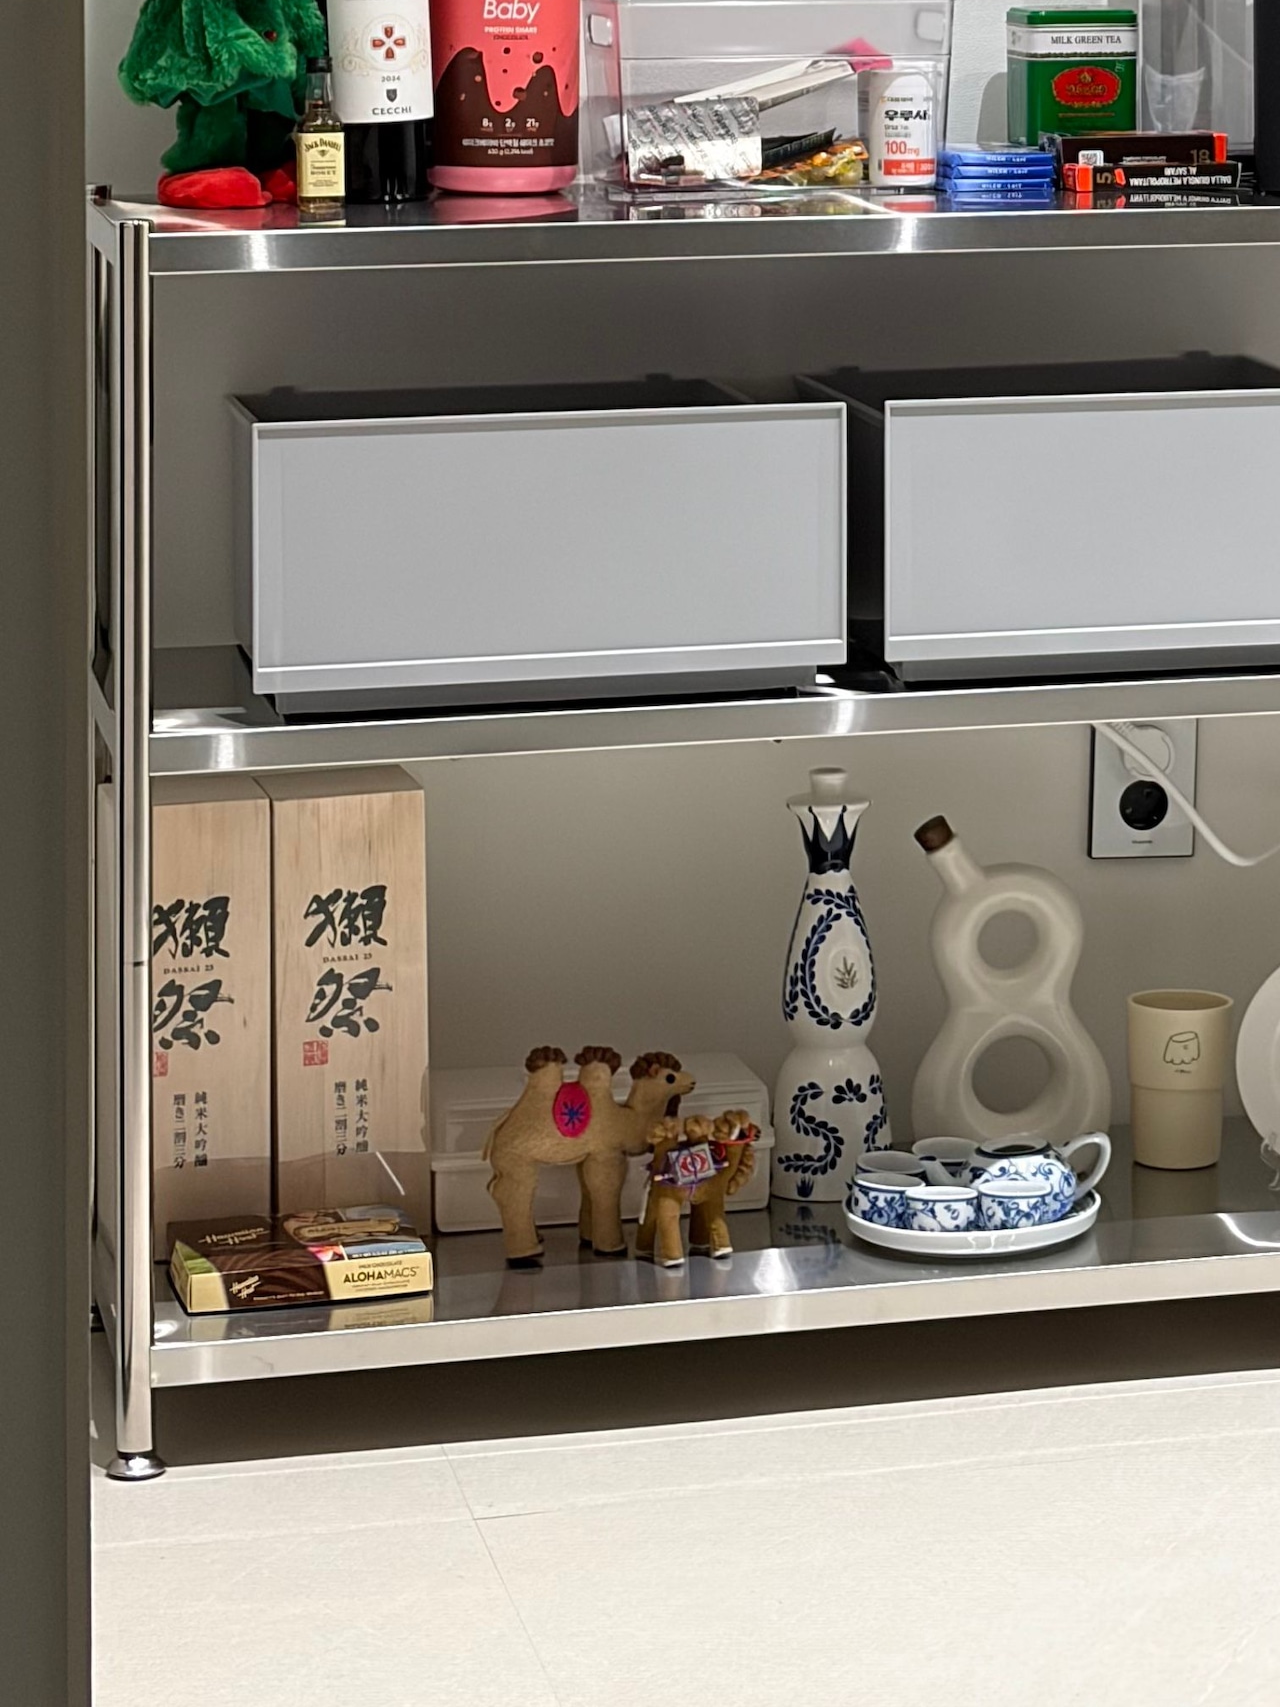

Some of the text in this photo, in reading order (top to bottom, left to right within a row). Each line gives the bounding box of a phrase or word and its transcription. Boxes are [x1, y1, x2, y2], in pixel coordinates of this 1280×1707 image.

[1051, 35, 1122, 44] MILK GREEN TEA
[371, 106, 412, 115] CECCHI
[1164, 167, 1187, 176] SAFARI
[1129, 177, 1181, 186] METROPOLITANA
[1211, 175, 1232, 184] DALLA
[322, 953, 359, 963] DASSAI
[163, 964, 214, 974] DASSAI 23
[343, 1267, 417, 1283] ALOHAMACS
